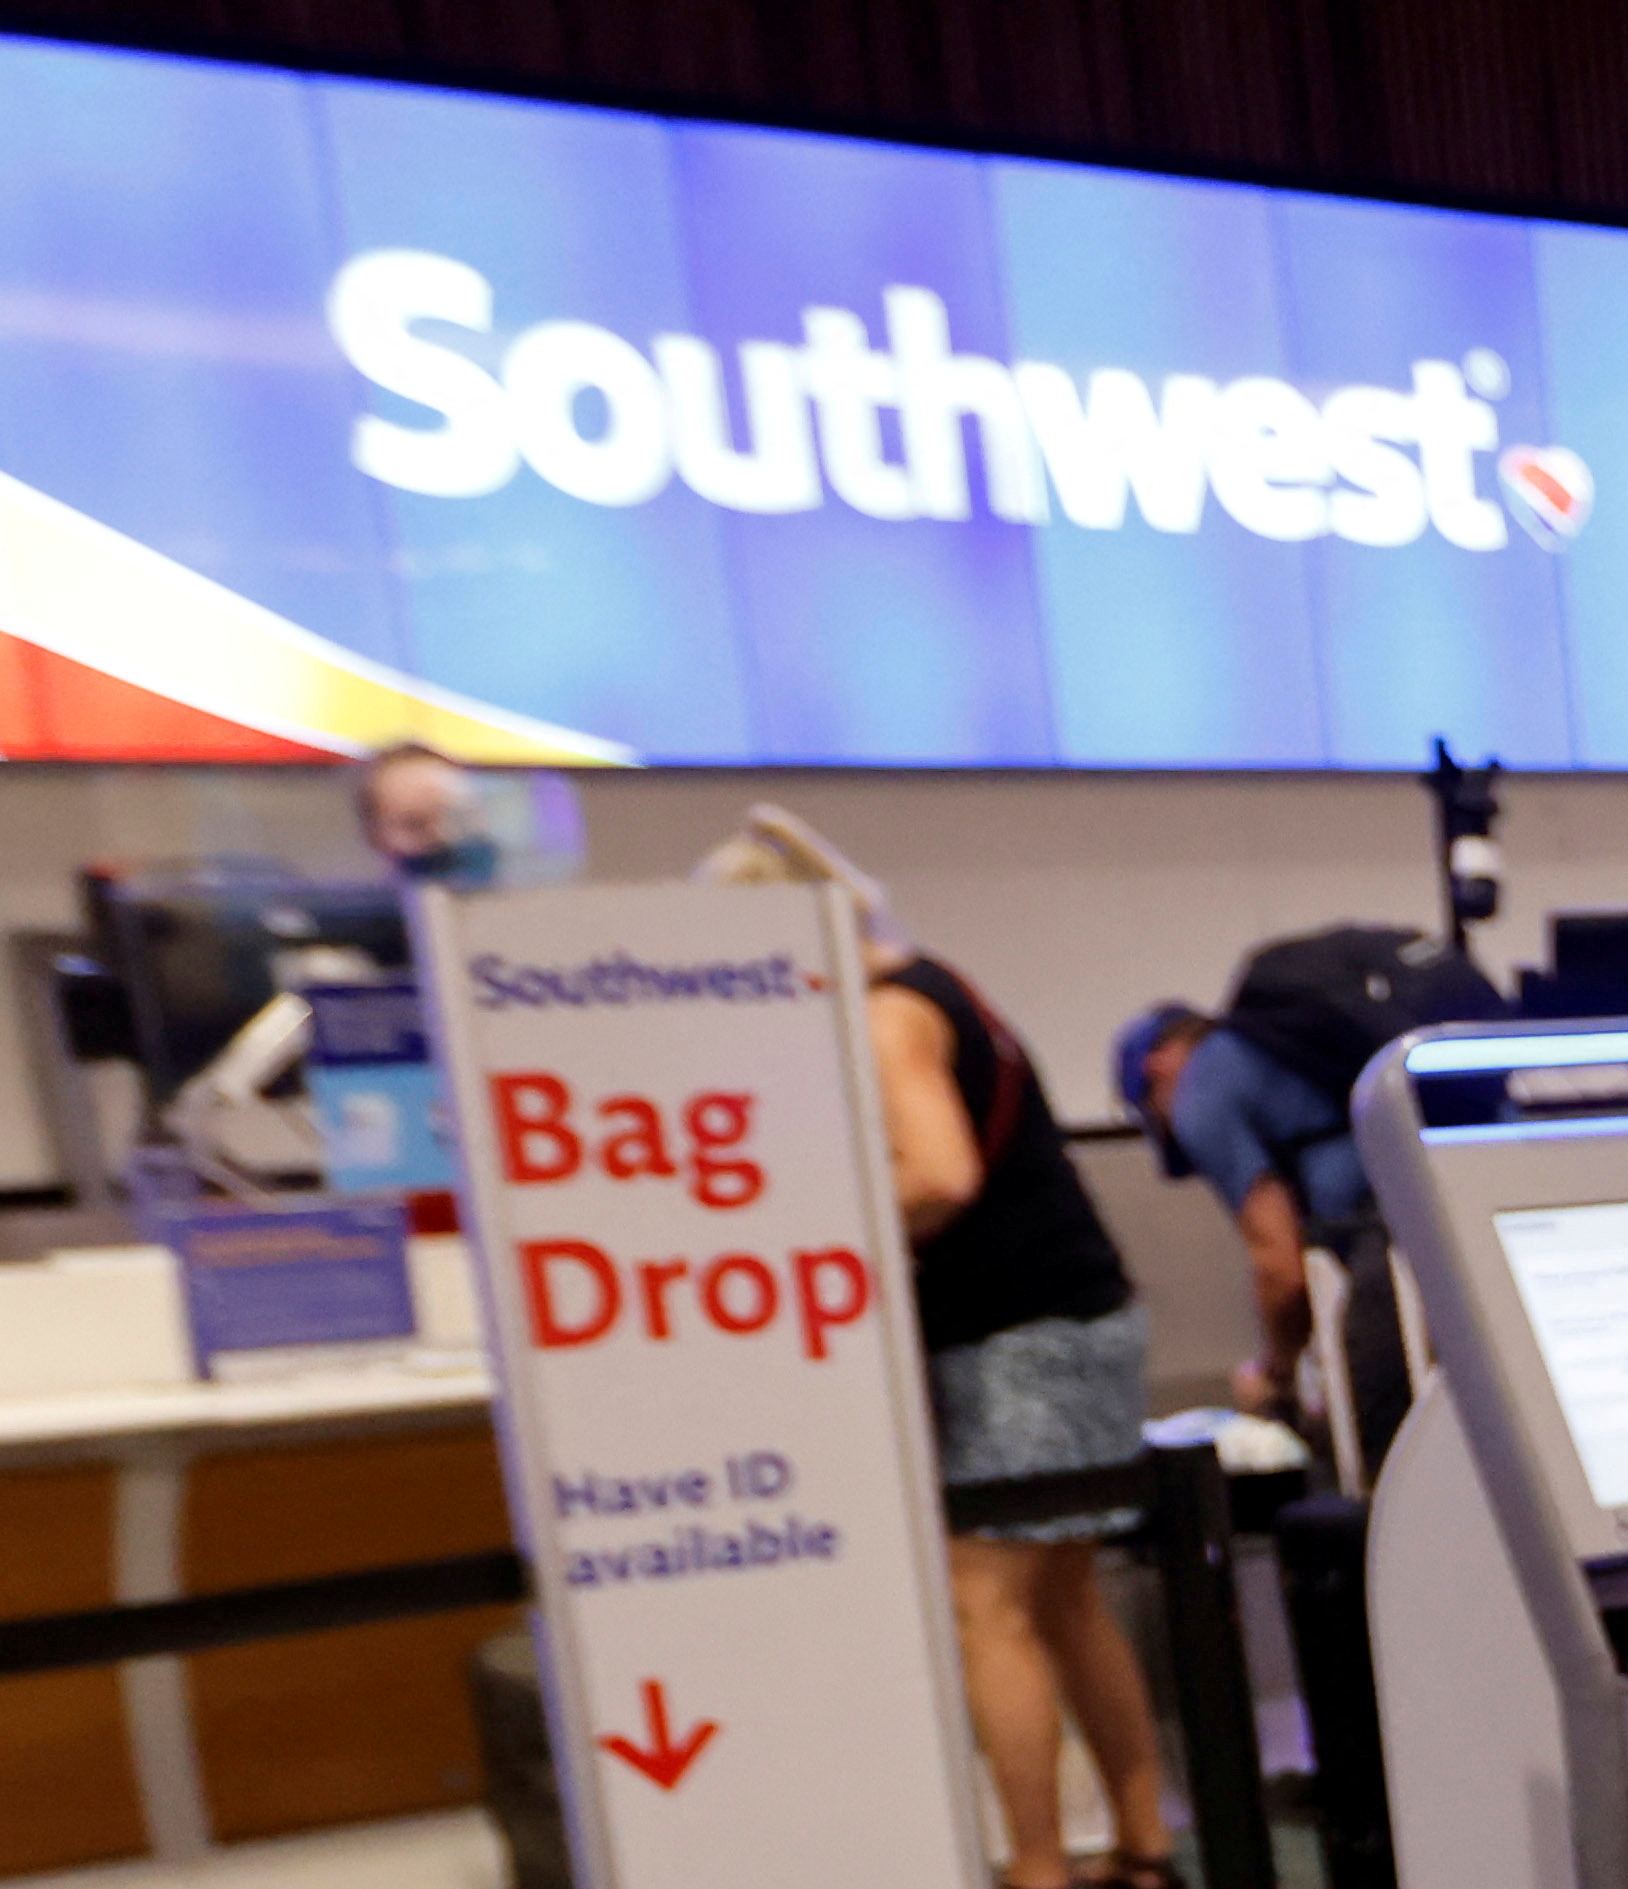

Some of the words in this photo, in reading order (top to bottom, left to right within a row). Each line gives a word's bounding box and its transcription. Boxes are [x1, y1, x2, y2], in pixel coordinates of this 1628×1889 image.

[326, 247, 1508, 552] Southwest
[471, 950, 798, 1010] Southwest
[486, 1072, 768, 1210] Bag
[517, 1238, 872, 1360] Drop
[553, 1464, 710, 1520] Have
[729, 1451, 795, 1500] ID
[566, 1514, 843, 1588] available
